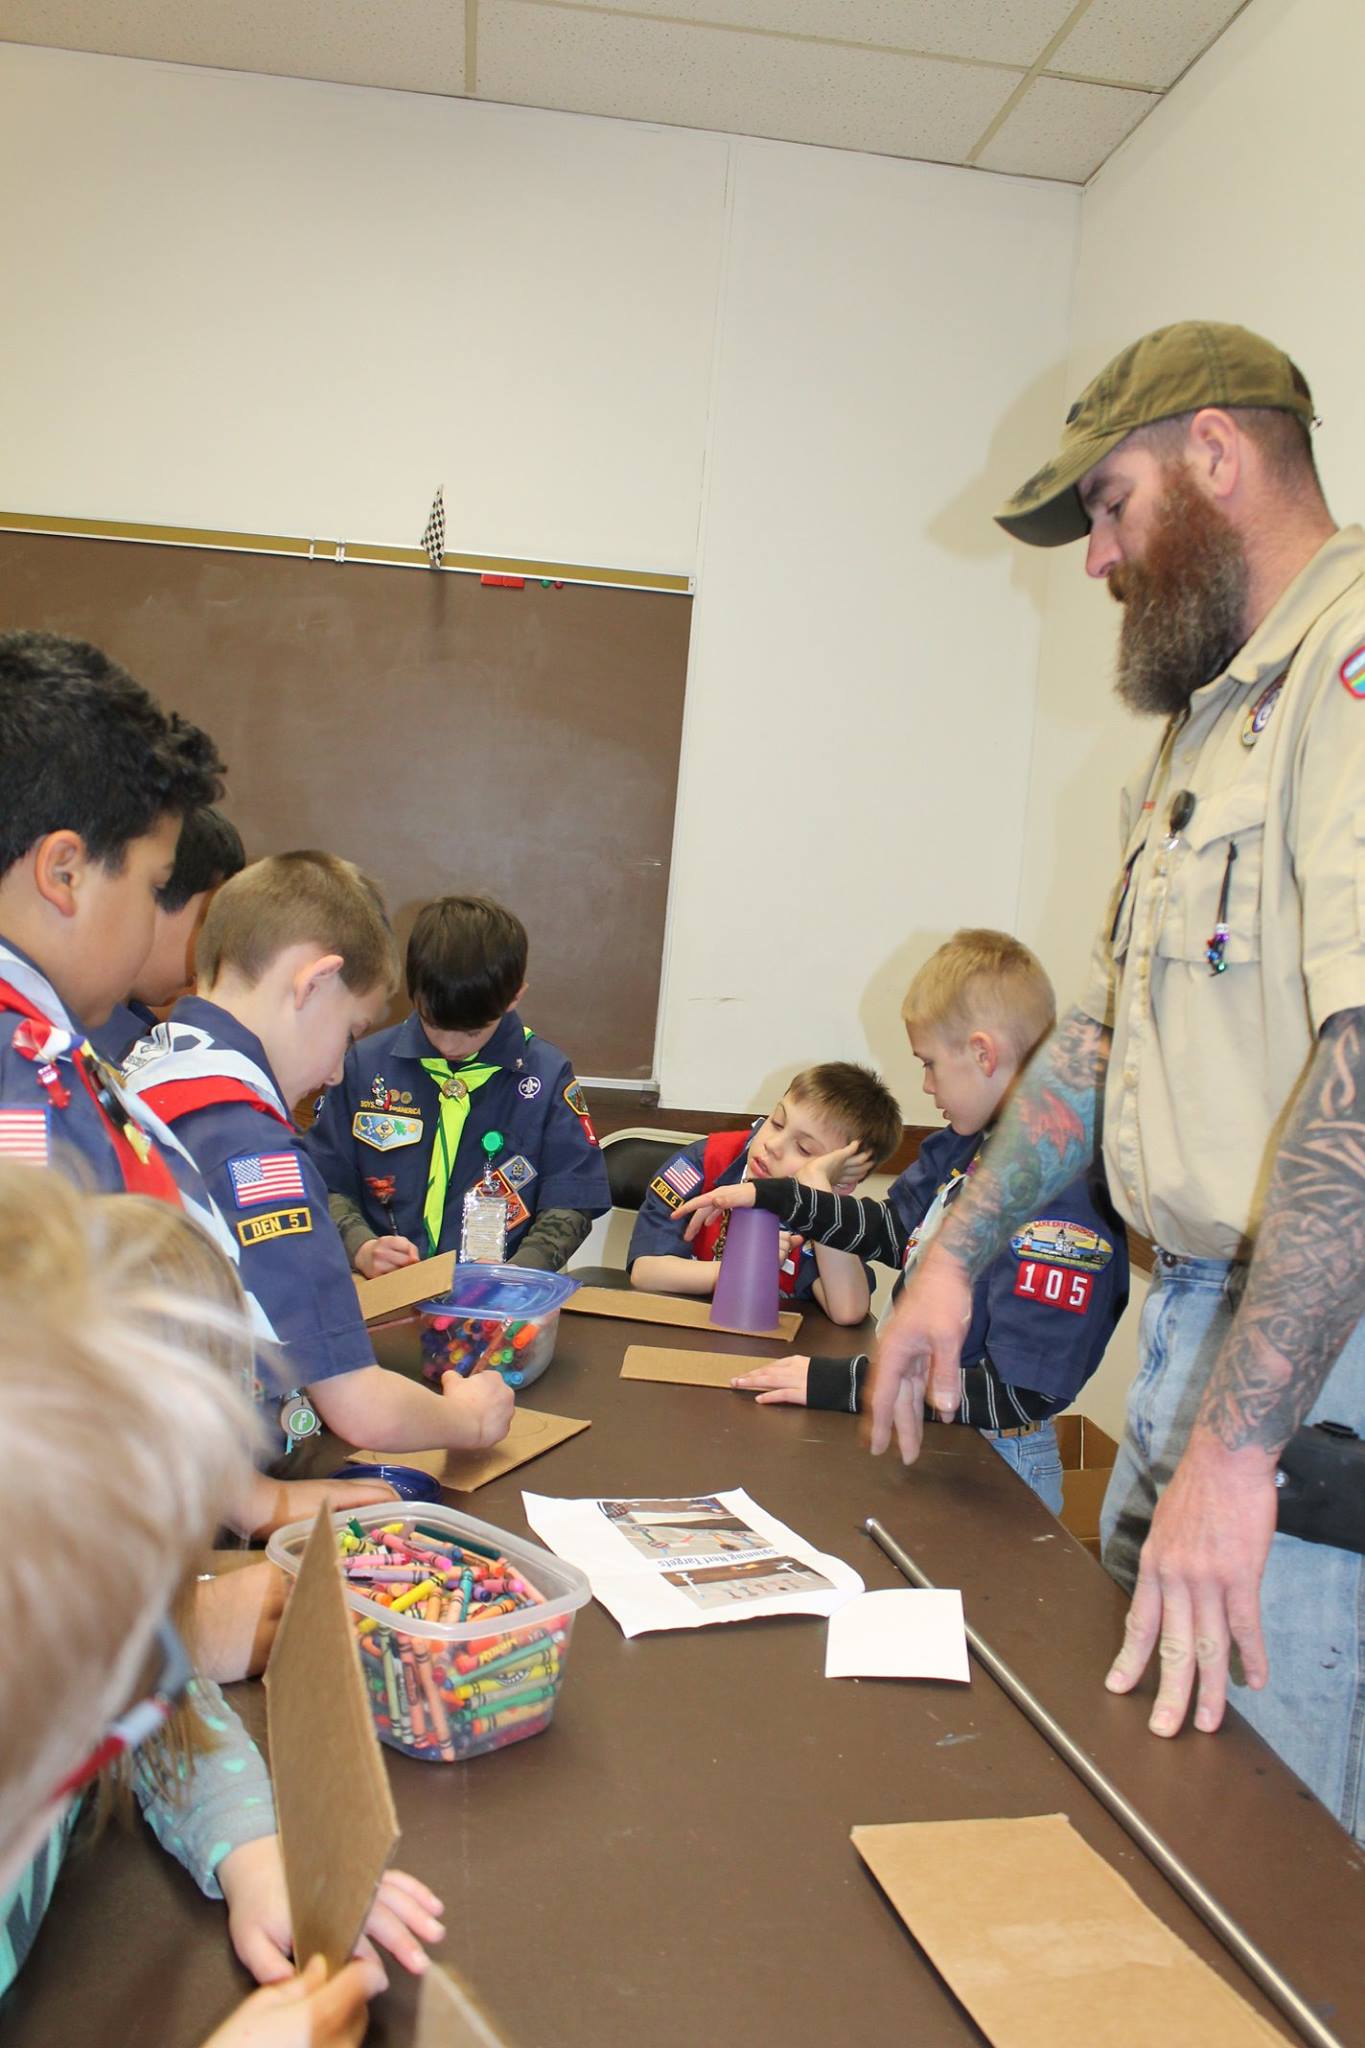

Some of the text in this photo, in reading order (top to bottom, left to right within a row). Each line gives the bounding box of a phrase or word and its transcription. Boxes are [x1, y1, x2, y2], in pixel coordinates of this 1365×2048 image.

[251, 1213, 300, 1238] DEN 5
[1019, 1263, 1088, 1306] 105
[658, 1557, 702, 1569] Targets
[729, 1548, 779, 1560] Spinning
